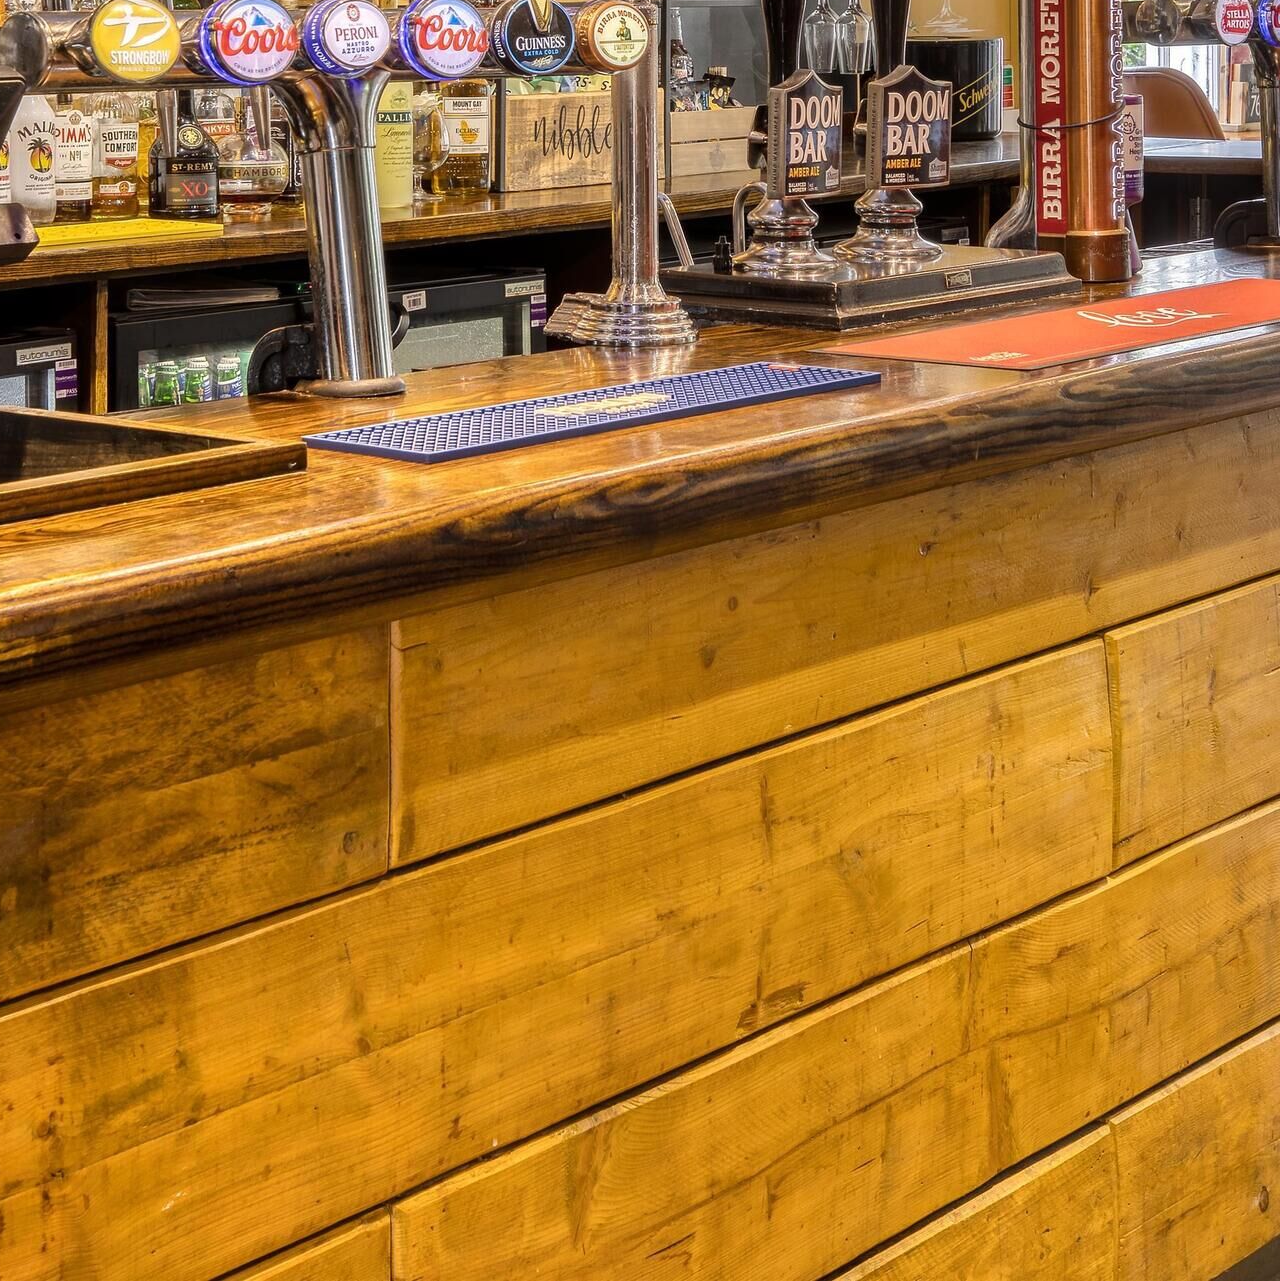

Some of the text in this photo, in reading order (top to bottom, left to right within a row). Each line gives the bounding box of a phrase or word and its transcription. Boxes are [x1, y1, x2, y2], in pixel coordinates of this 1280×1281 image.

[597, 12, 617, 34] BIRRA
[617, 10, 646, 33] MORETTI
[1226, 11, 1250, 20] STELLA
[1226, 19, 1250, 28] ARTOIS
[213, 17, 298, 56] Coors
[335, 26, 378, 42] PERONI
[409, 15, 489, 53] Coors
[493, 20, 506, 58] GUINNESS
[342, 46, 375, 54] AZZURRO
[516, 36, 566, 51] GUINNESS
[111, 49, 170, 65] STRONGBOW
[523, 49, 543, 57] EXTRA
[790, 95, 841, 130] DOOM
[887, 90, 949, 123] DOOM
[105, 142, 137, 153] COMFORT
[789, 130, 827, 164] BAR
[886, 124, 931, 156] BAR
[886, 158, 921, 169] AMBER ALE
[1042, 118, 1062, 220] BIRRA
[789, 166, 820, 178] AMBER ALE
[180, 181, 208, 197] XO
[20, 347, 69, 361] autonumis
